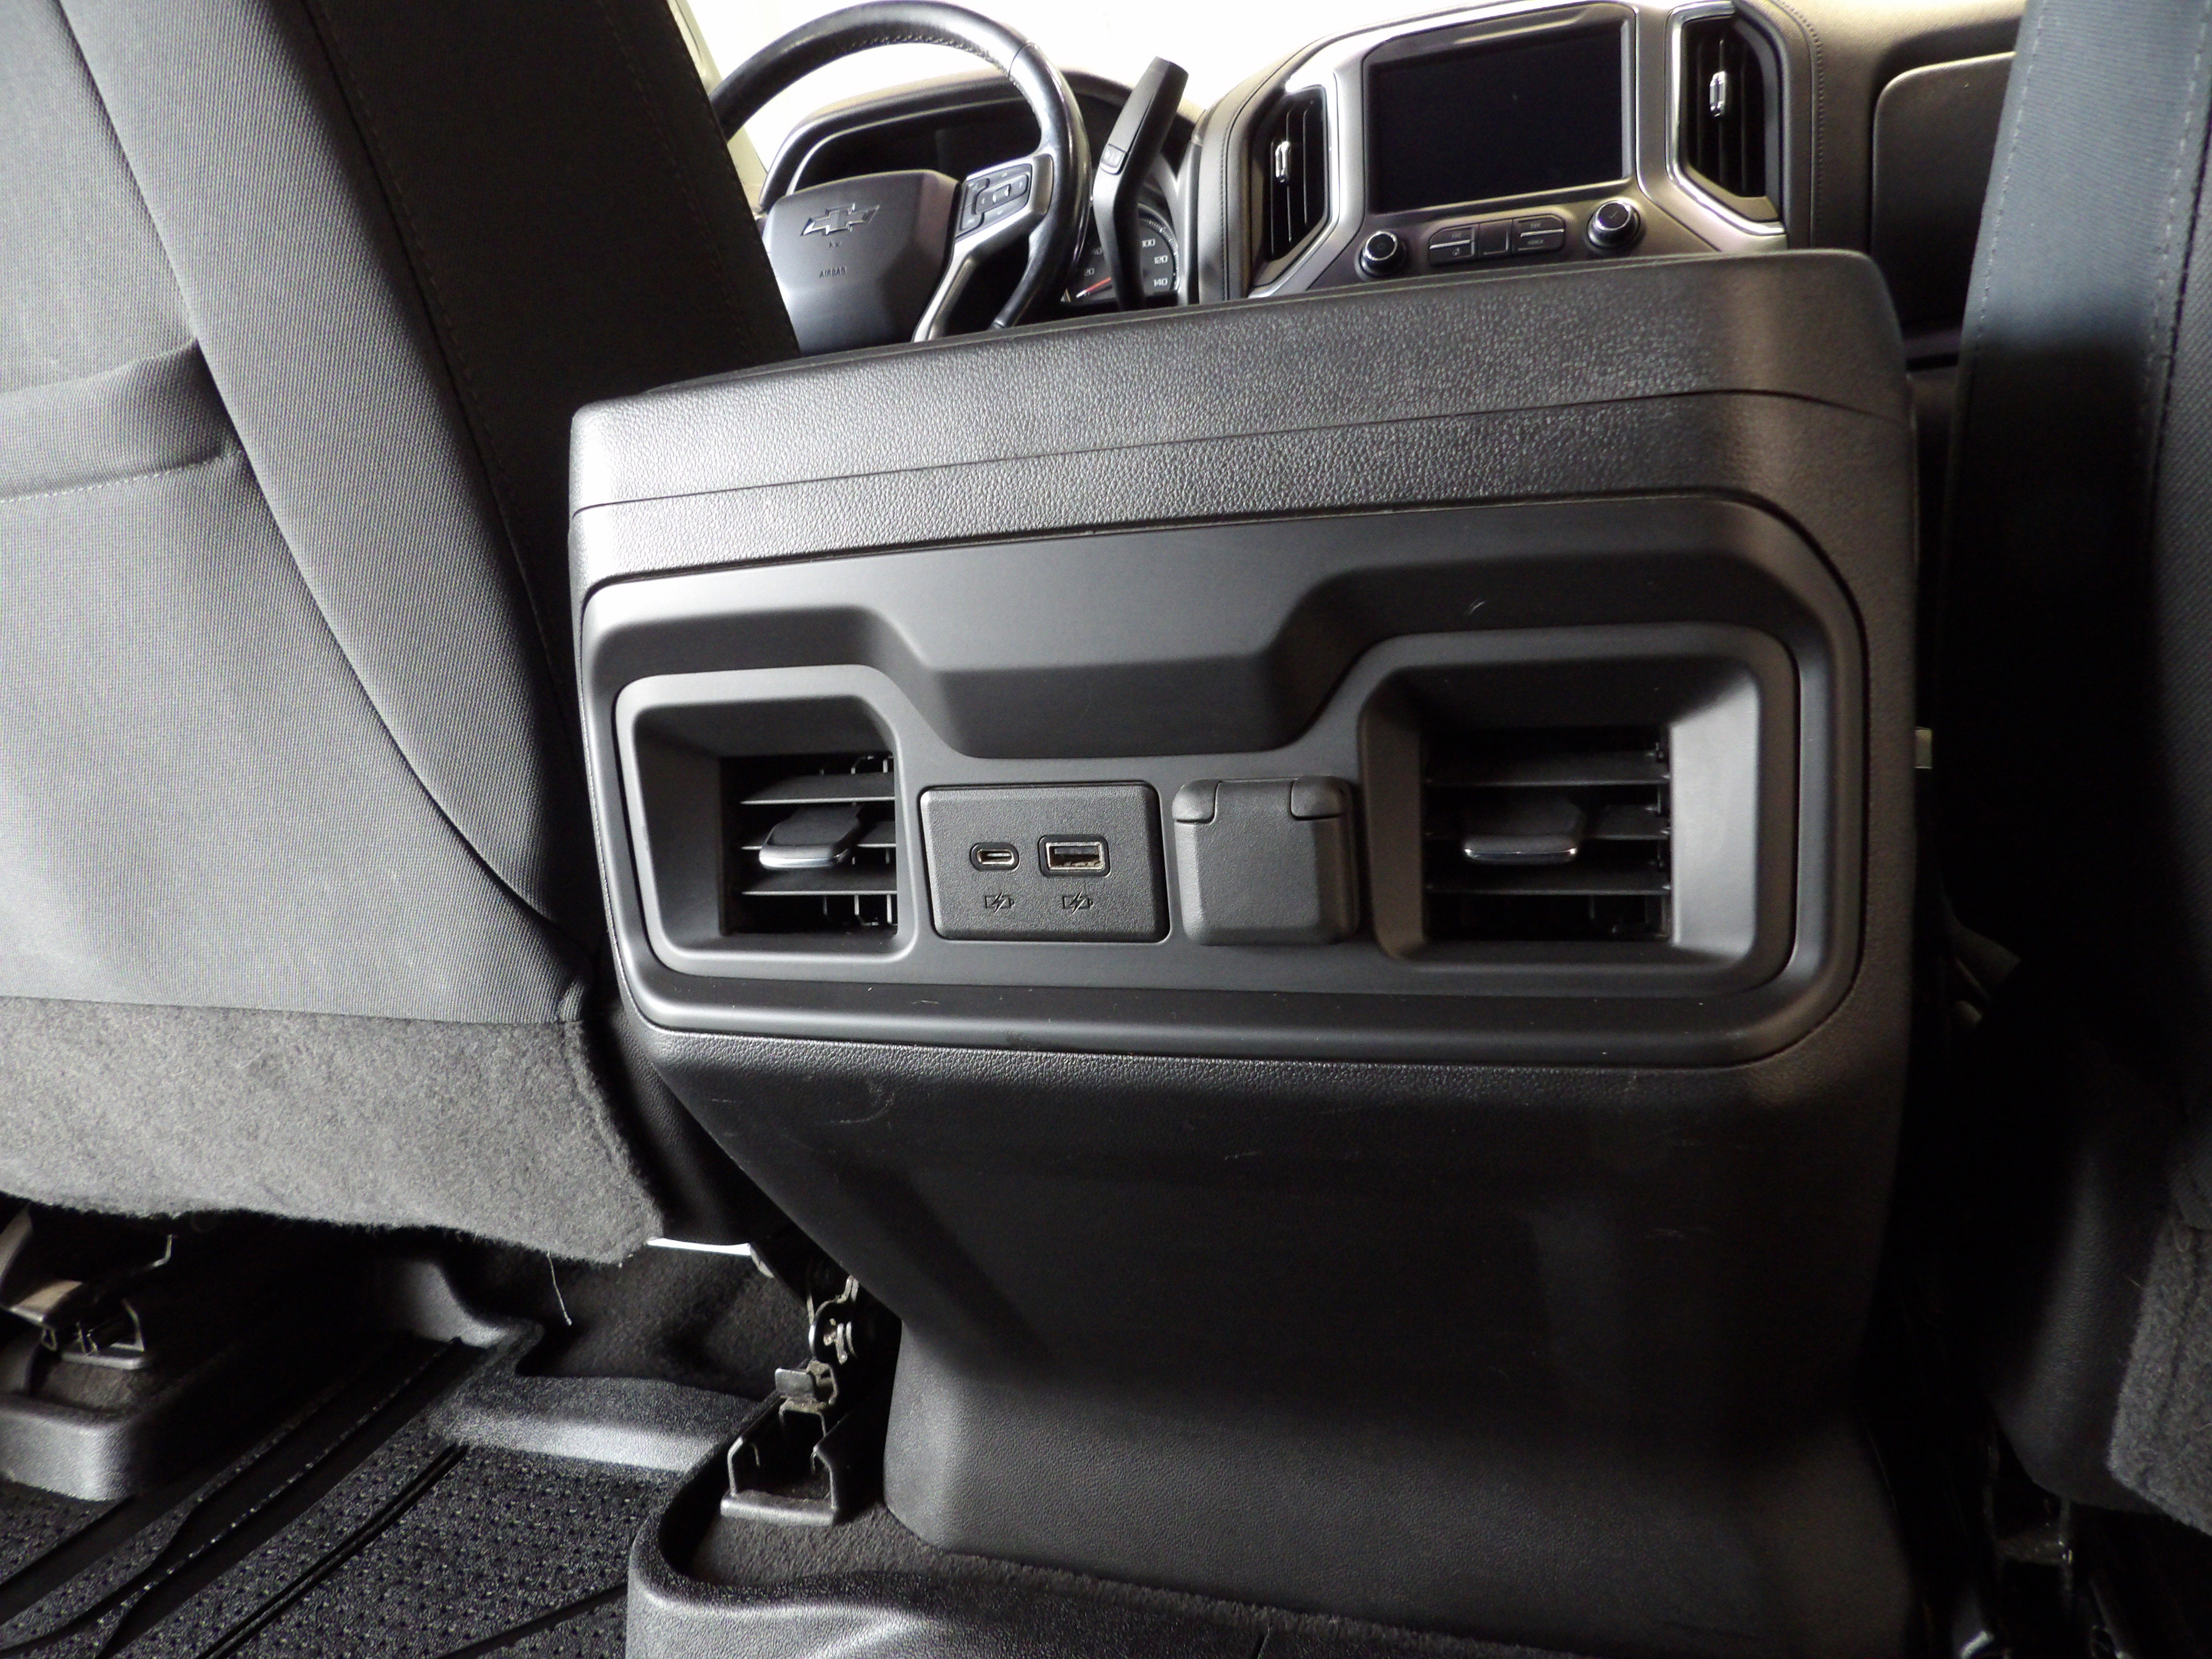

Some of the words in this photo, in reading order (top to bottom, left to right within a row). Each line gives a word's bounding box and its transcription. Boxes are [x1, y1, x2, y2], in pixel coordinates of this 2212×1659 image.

[1142, 239, 1155, 247] 100
[1154, 255, 1168, 264] 120
[819, 266, 845, 278] AIRBAG
[1154, 277, 1168, 287] 140
